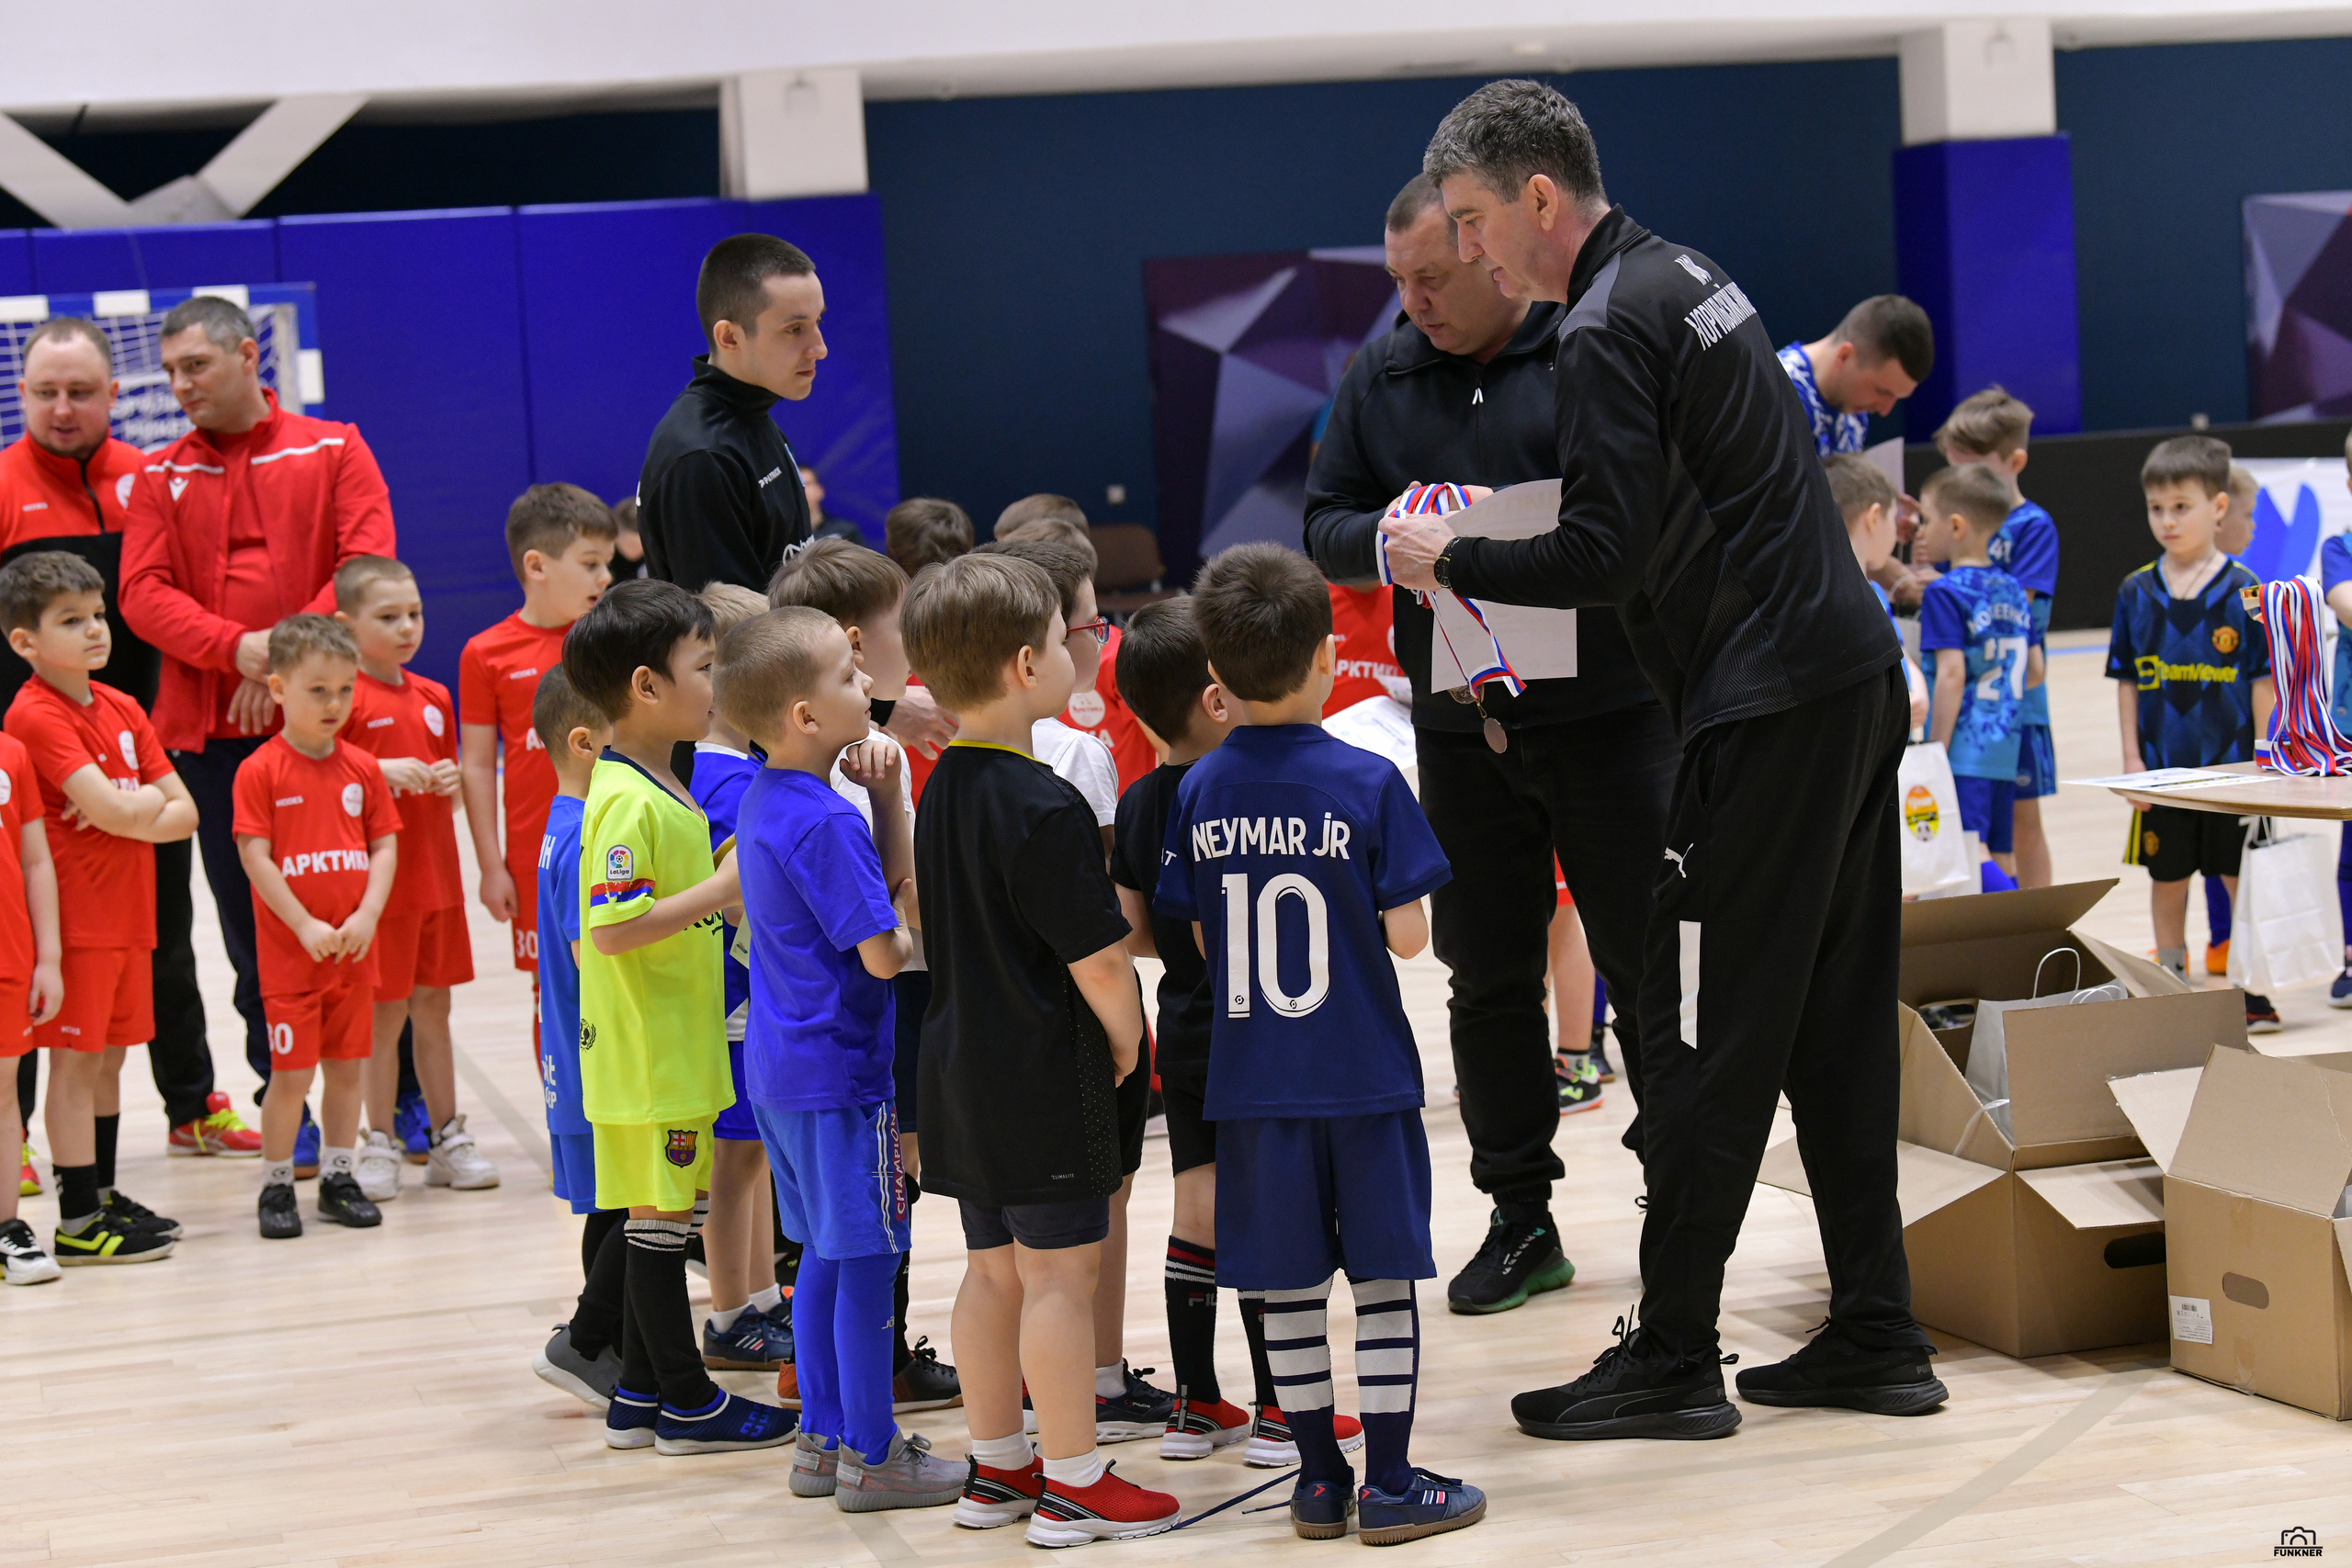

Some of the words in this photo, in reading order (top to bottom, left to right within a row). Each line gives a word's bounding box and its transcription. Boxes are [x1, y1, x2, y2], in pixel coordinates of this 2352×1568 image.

[1976, 636, 2029, 701] 27
[609, 868, 629, 876] LaLiga
[1193, 817, 1306, 862] NEYMAR
[1221, 873, 1330, 1019] 10
[890, 1112, 906, 1215] CHAMPION
